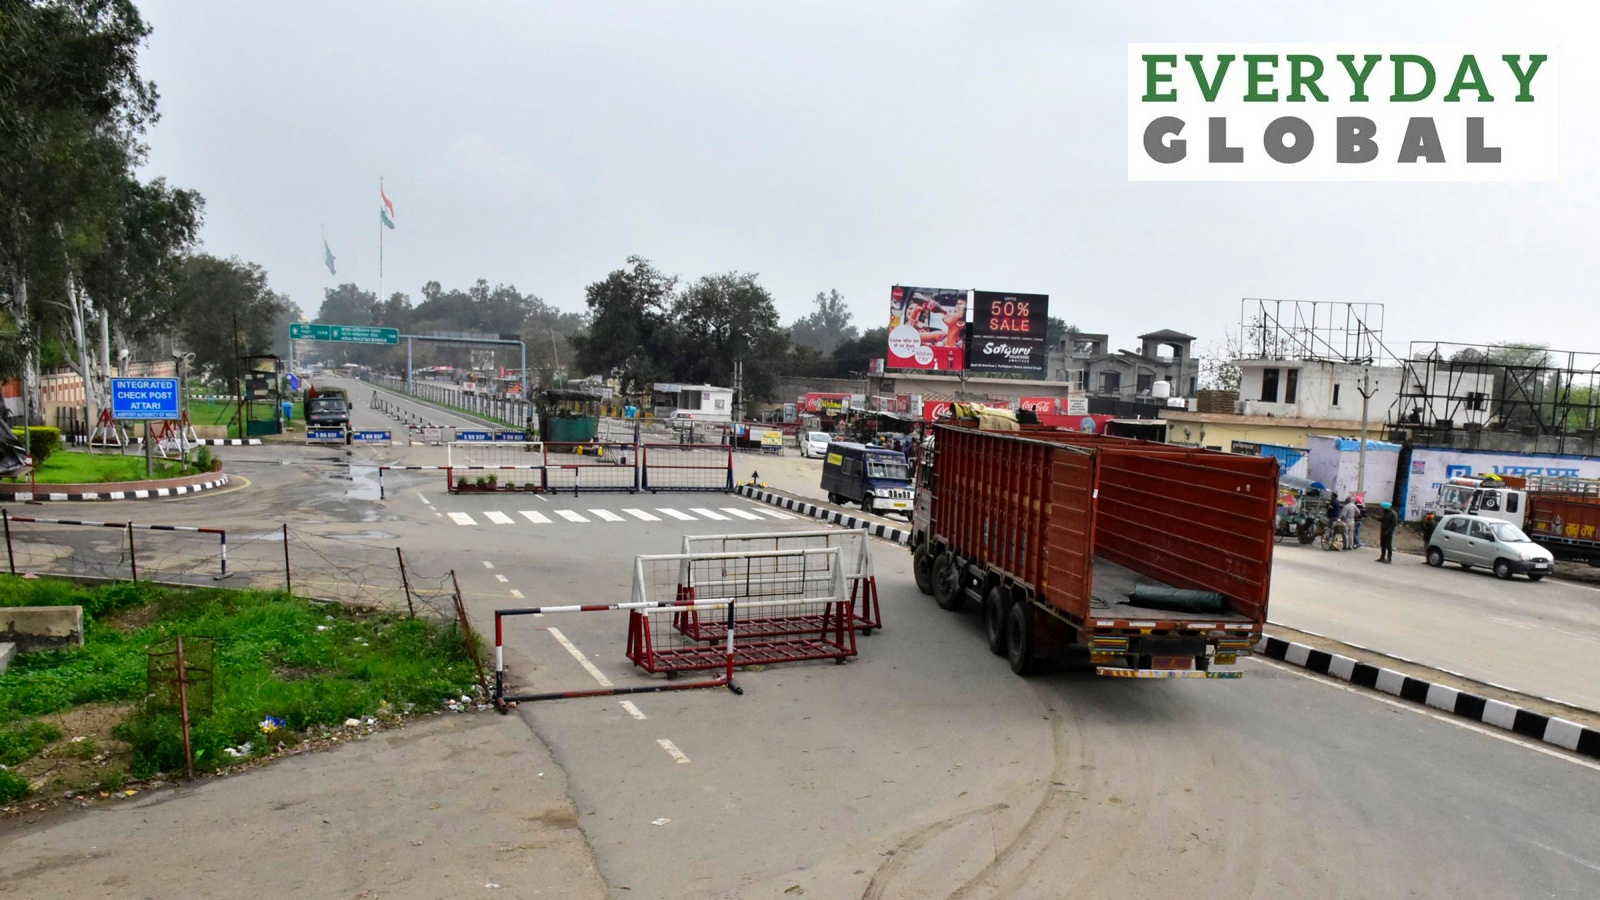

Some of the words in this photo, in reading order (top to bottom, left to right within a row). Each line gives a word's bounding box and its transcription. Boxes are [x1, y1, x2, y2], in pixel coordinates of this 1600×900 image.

[991, 301, 1030, 317] 50%
[989, 318, 1030, 332] SALE
[982, 342, 1031, 358] Satguru
[117, 381, 173, 389] INTEGRATED
[117, 391, 147, 399] CHECK
[149, 391, 172, 399] POST
[1022, 400, 1051, 412] CocaCola
